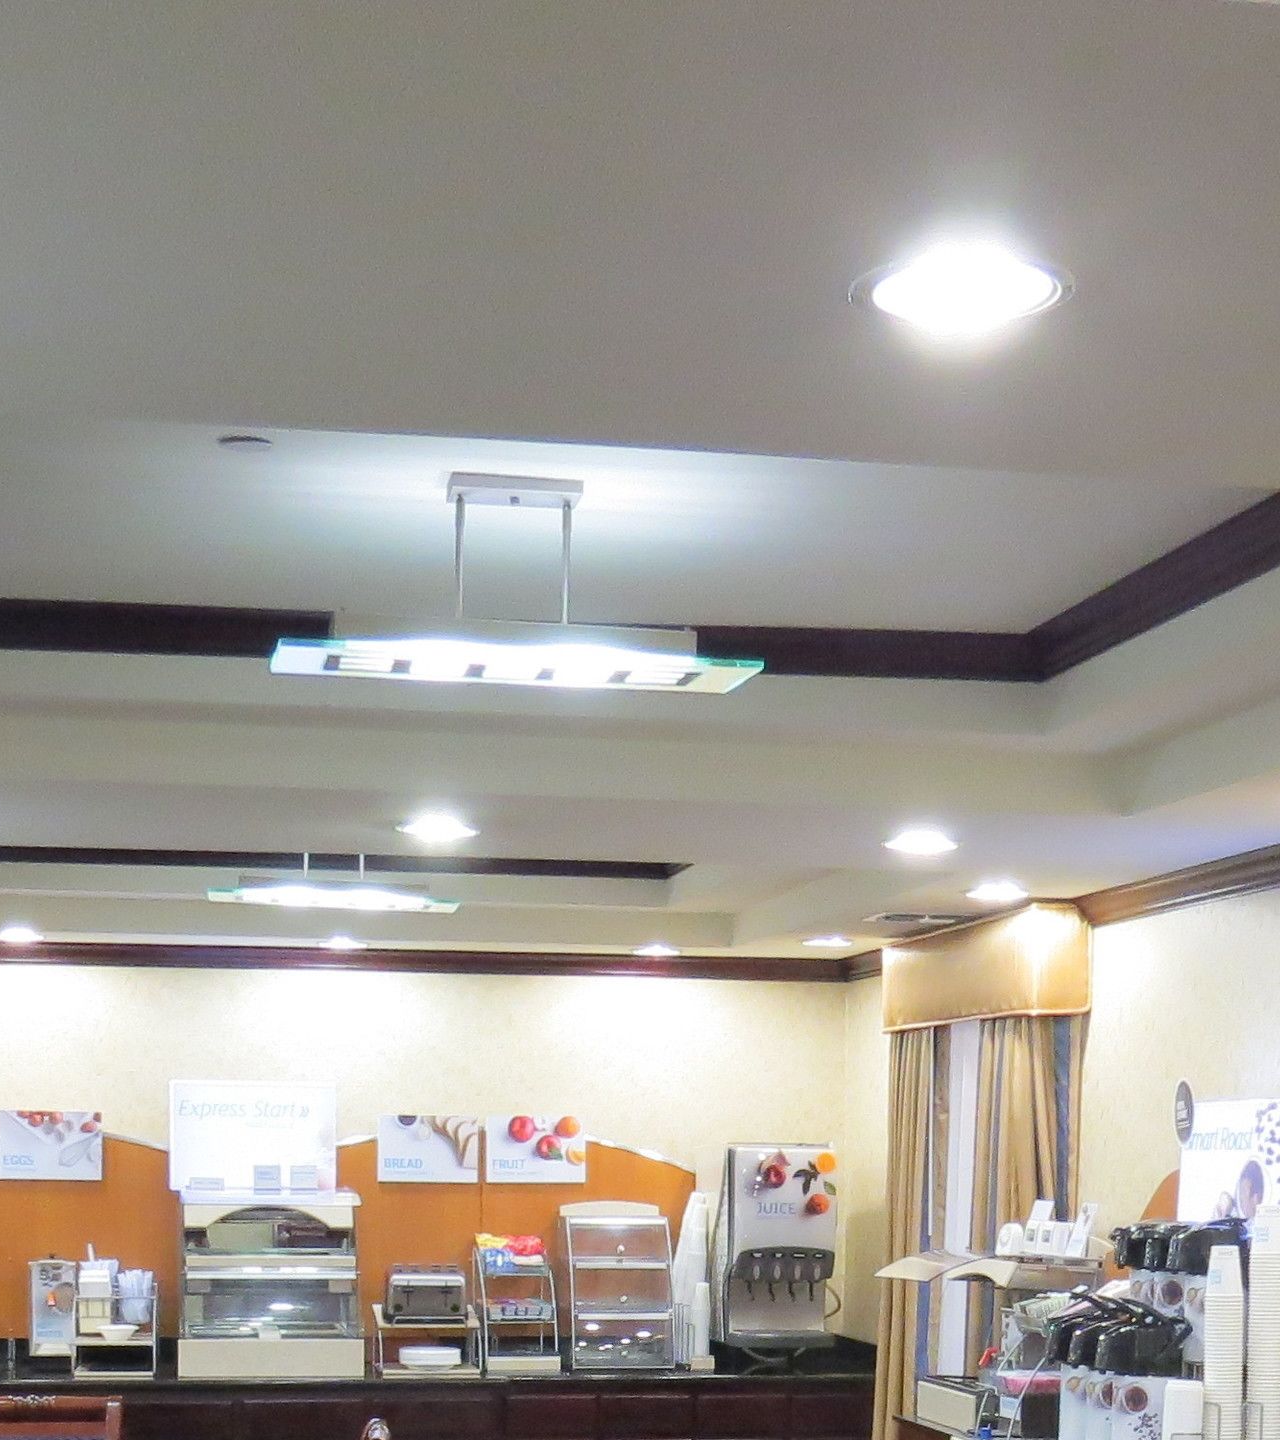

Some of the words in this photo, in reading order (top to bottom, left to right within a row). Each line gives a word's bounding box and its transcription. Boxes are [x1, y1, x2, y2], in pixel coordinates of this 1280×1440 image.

[2, 1155, 35, 1166] EGGS
[383, 1157, 423, 1169] BREAD
[492, 1158, 526, 1170] FRUIT
[758, 1202, 797, 1215] JUICE
